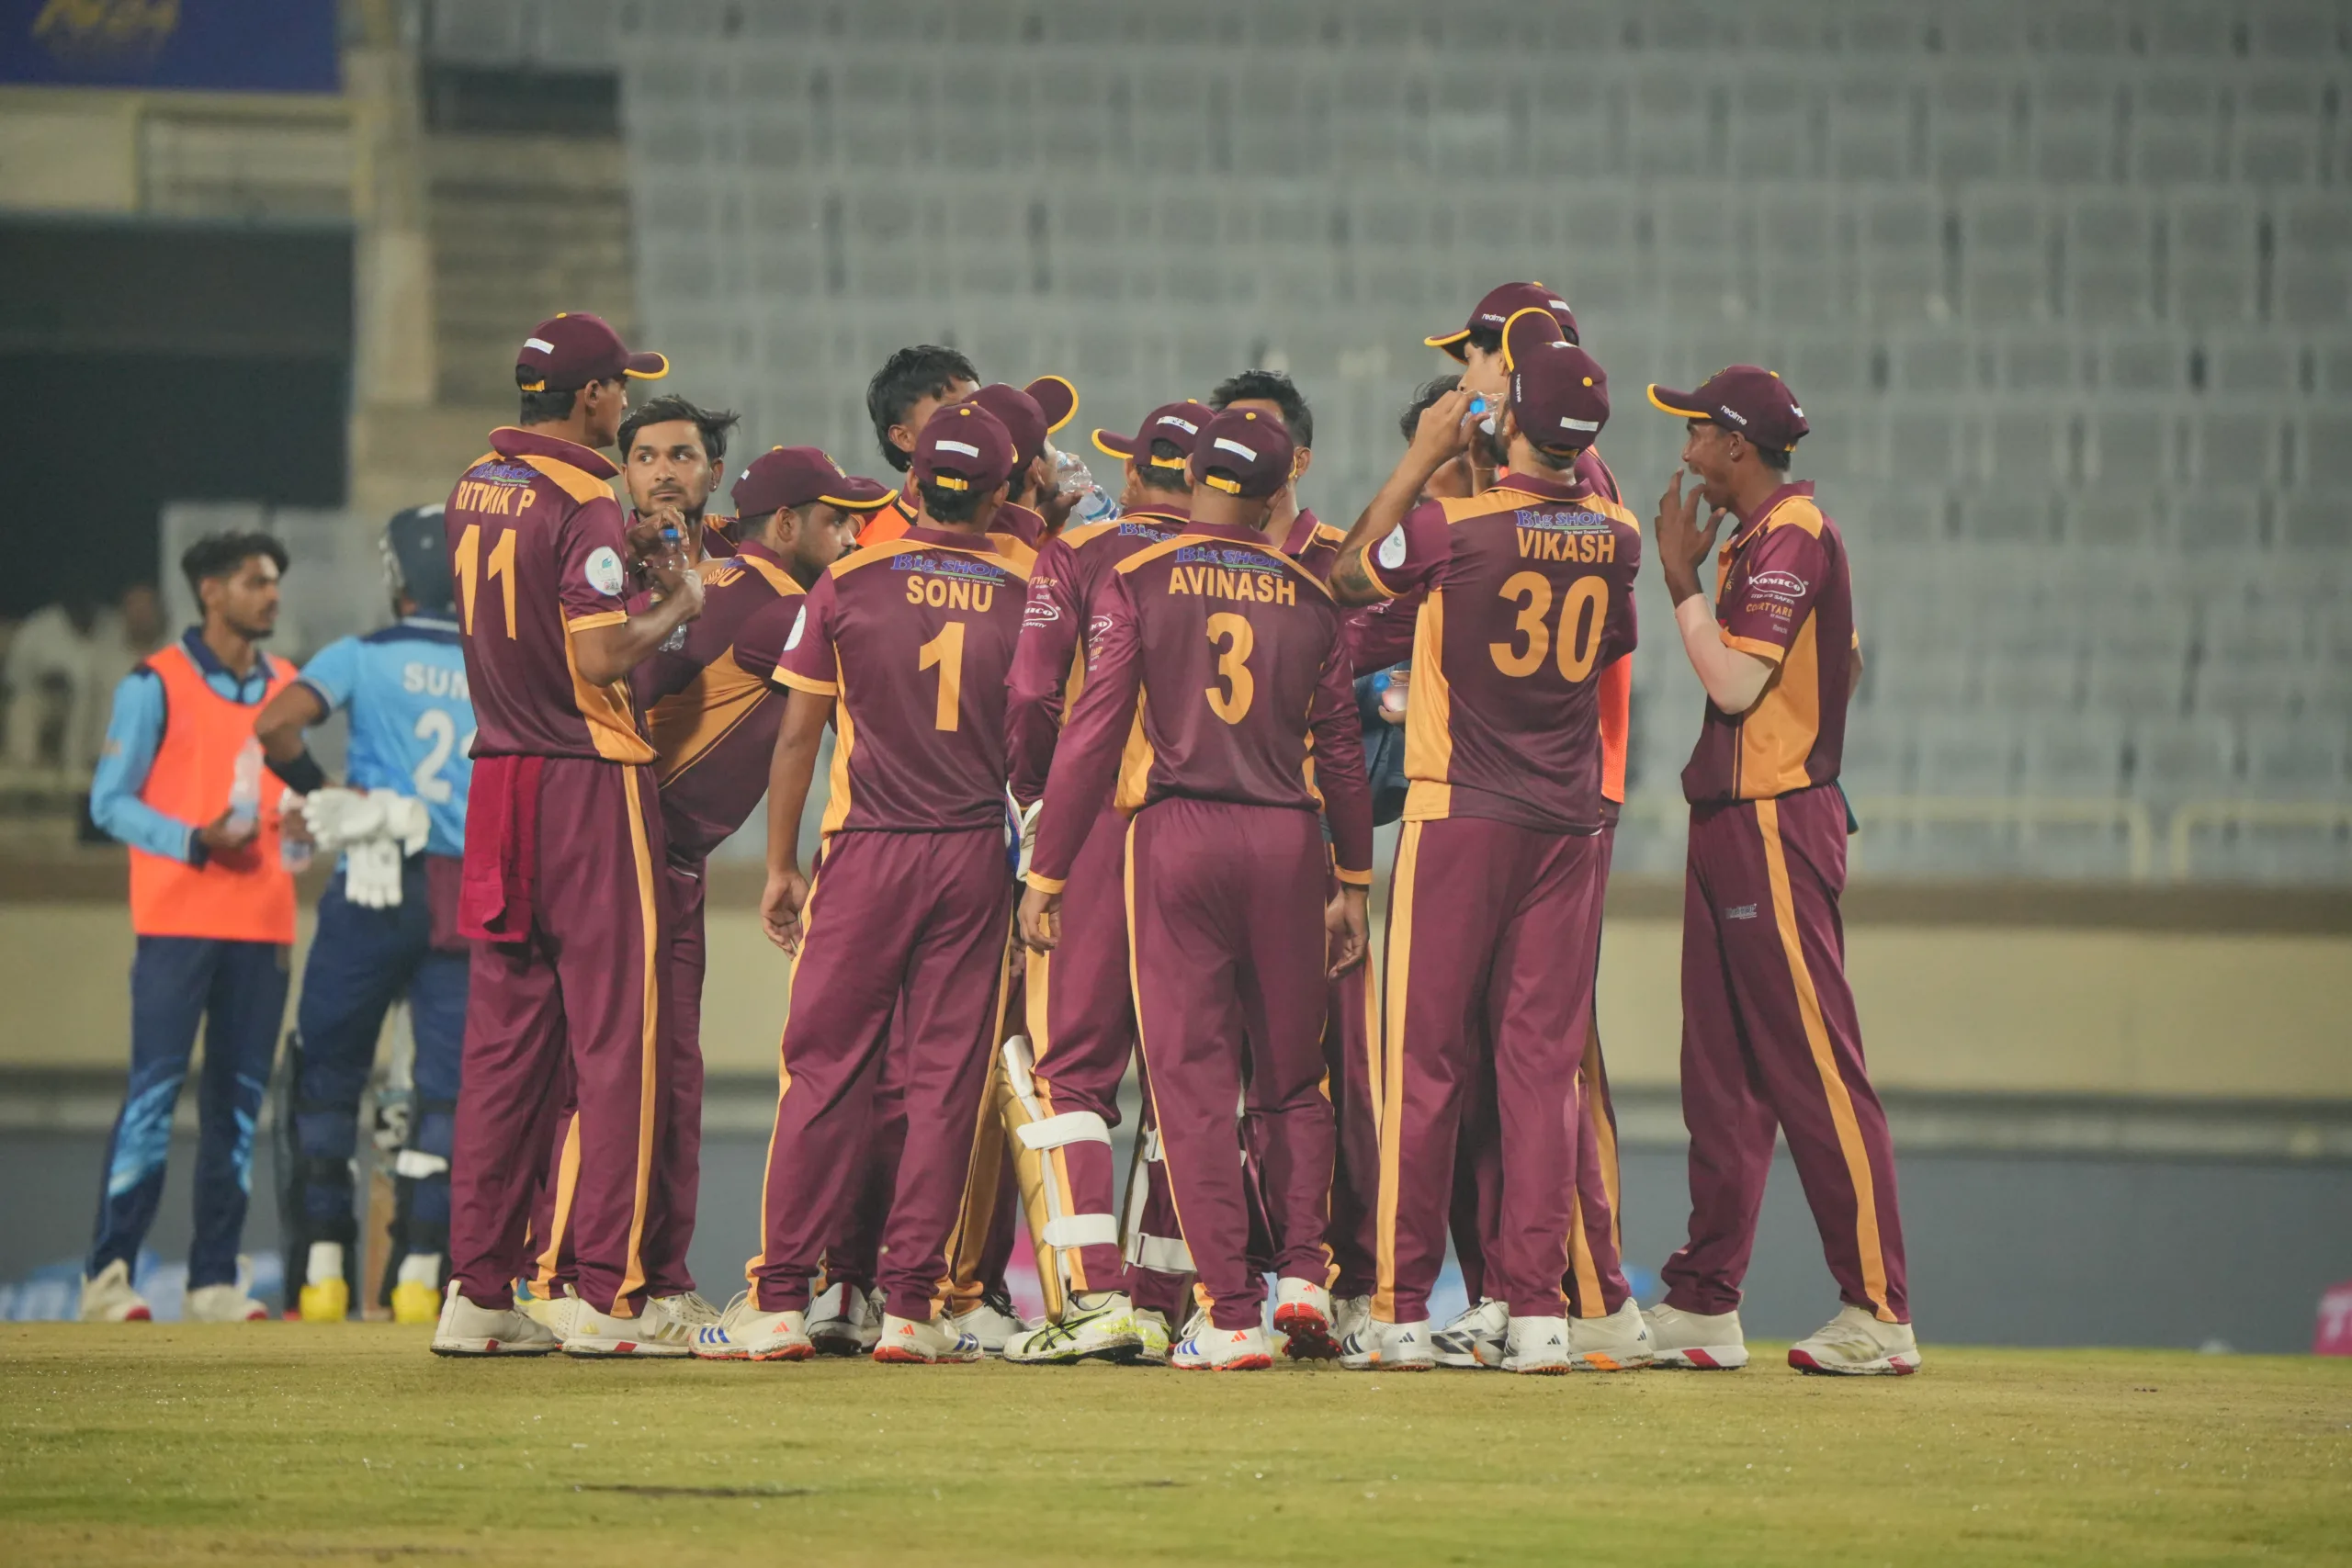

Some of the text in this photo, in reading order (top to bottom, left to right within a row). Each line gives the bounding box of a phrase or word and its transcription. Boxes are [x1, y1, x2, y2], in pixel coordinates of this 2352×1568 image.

[1481, 312, 1507, 323] realme
[1720, 405, 1747, 425] realme
[515, 488, 537, 517] P
[1555, 512, 1606, 526] SHOP
[1221, 550, 1284, 568] SHOP
[1516, 527, 1615, 563] VIKASH
[455, 524, 516, 640] 11
[940, 559, 1006, 578] SHOP
[1168, 567, 1295, 606] AVINASH
[906, 575, 994, 613] SONU
[1746, 602, 1792, 617] CORTYARD
[1489, 570, 1609, 682] 30
[918, 621, 966, 732] 1
[1204, 611, 1255, 724] 3
[413, 708, 478, 805] 2
